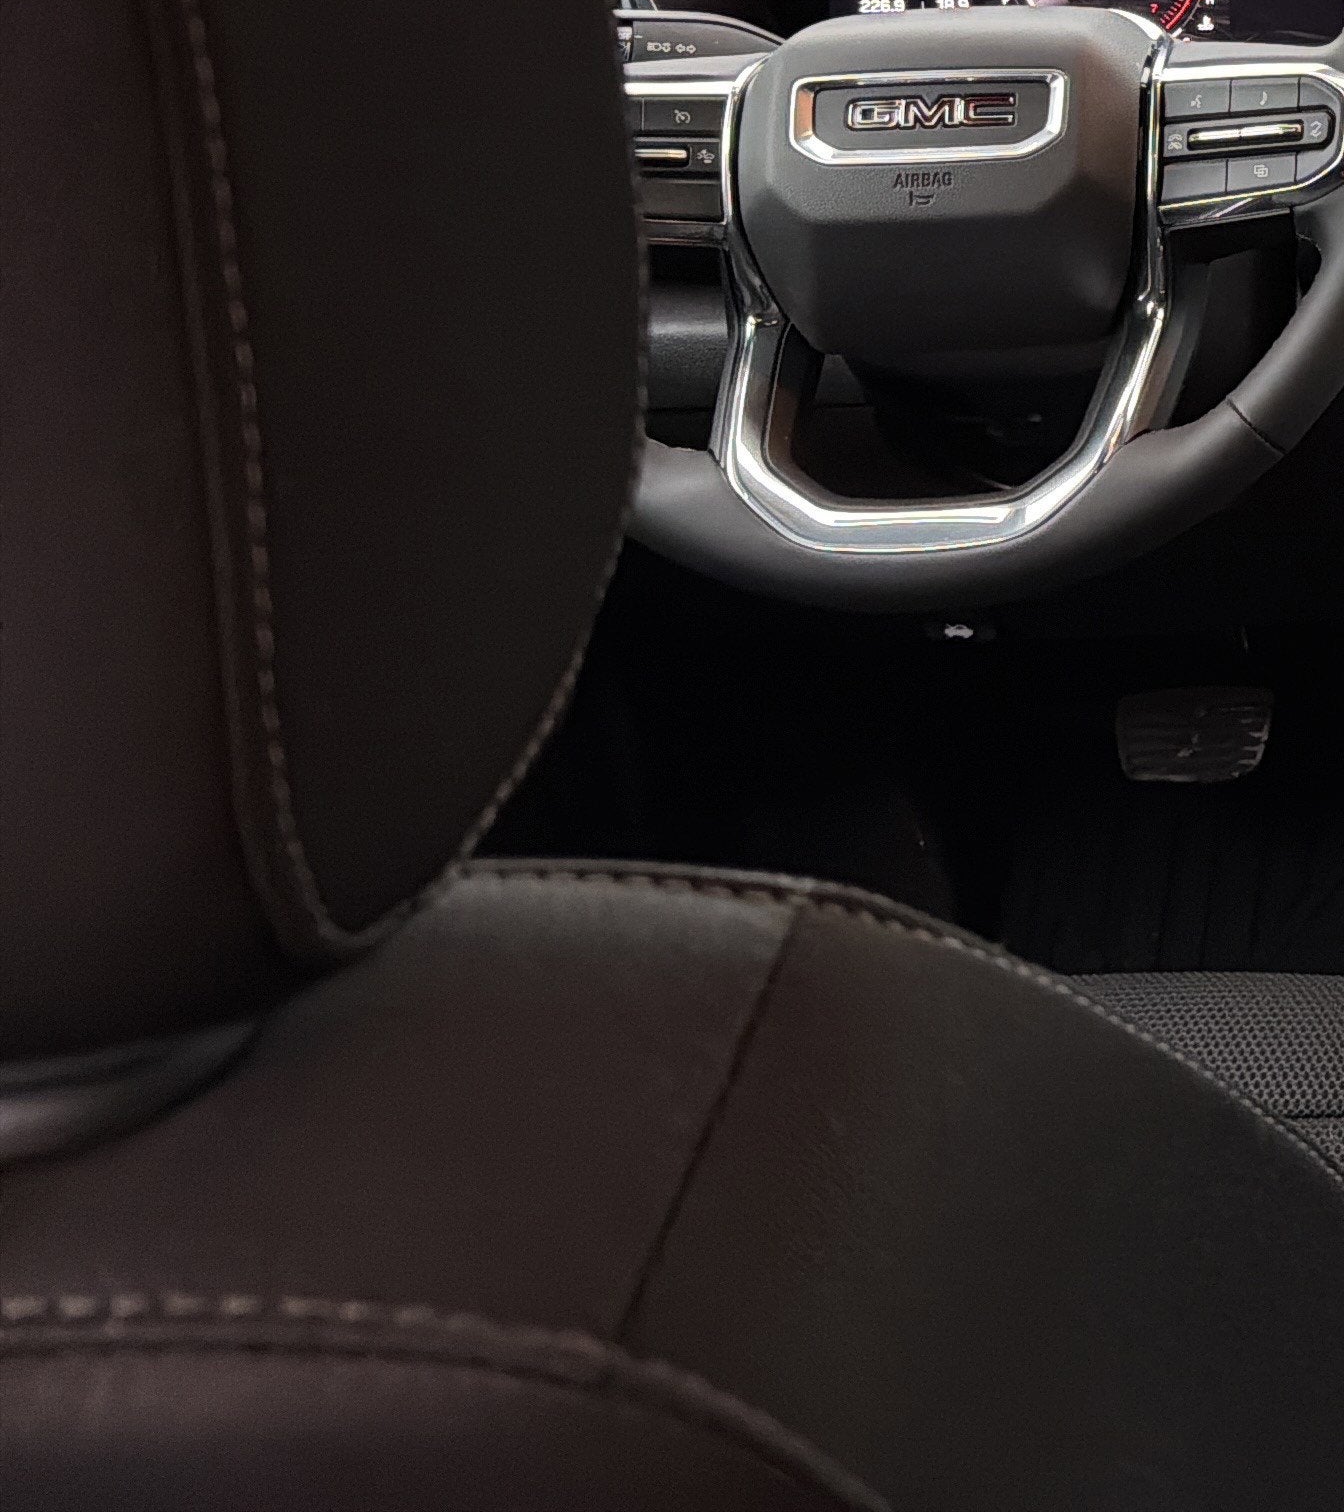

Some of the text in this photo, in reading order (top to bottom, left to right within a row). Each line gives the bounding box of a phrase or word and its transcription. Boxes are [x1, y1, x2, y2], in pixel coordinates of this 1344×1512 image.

[858, 0, 905, 13] 226.9
[1151, 4, 1159, 14] 7
[847, 92, 1017, 131] GMC
[894, 171, 953, 188] AIRBAG
